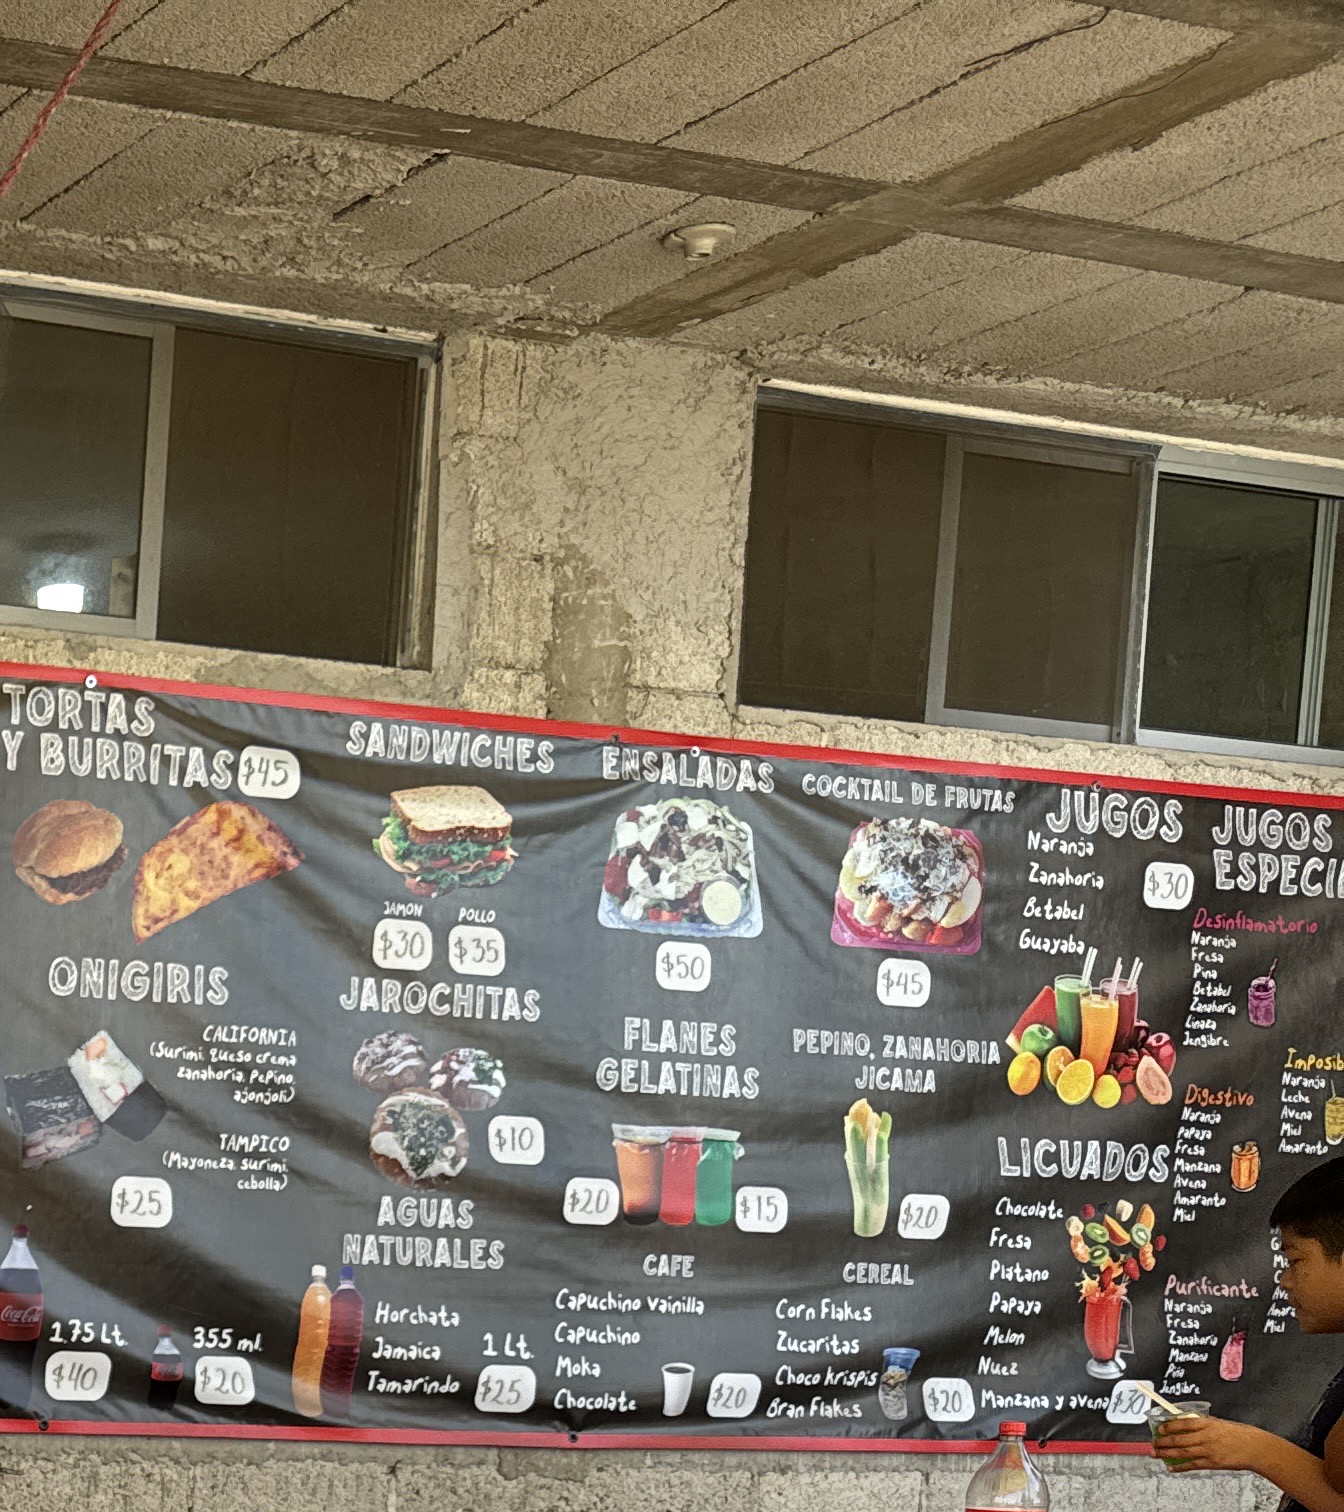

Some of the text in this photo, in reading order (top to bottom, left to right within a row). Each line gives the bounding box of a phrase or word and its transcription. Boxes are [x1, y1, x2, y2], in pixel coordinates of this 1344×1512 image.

[3, 684, 155, 736] TORTAS
[1, 730, 235, 789] Y BURRITAS
[345, 721, 555, 773] SANDWICHES
[242, 757, 289, 788] $45
[602, 747, 775, 794] ENSALADAS
[802, 773, 1015, 813] COCKTAIL DE FRUTAS
[1046, 789, 1184, 841] JUGOS
[1212, 805, 1332, 851] JUGOS
[1027, 831, 1094, 858] Naranja
[1028, 862, 1105, 890] Zanahoria
[1148, 871, 1189, 899] $30
[383, 902, 423, 917] JAMON
[458, 907, 496, 923] POLLO
[1022, 896, 1085, 922] Betabel
[1193, 907, 1318, 935] Desinflamatorio
[377, 929, 426, 960] $30
[453, 937, 500, 964] $35
[1019, 931, 1086, 957] Guayaba
[1191, 930, 1237, 948] Naranja
[661, 950, 706, 981] $50
[1191, 947, 1224, 964] Fresa
[49, 957, 229, 1005] ONIGIRIS
[881, 968, 924, 996] $45
[339, 976, 541, 1022] JAROCHITAS
[1190, 997, 1237, 1015] Zanahoria
[1185, 1014, 1217, 1030] Linaza
[203, 1025, 296, 1047] CALIFORNIA
[624, 1017, 737, 1056] FLANES
[882, 1033, 1001, 1065] ZANAHORIA
[596, 1059, 760, 1099] GELATINAS
[855, 1065, 937, 1093] JICAMA
[1282, 1071, 1325, 1089] Naranja
[1184, 1083, 1255, 1107] Digestivo
[1281, 1089, 1310, 1103] Leche
[1180, 1106, 1221, 1124] Naranja
[1280, 1105, 1312, 1121] Avena
[494, 1126, 534, 1152] $10
[1280, 1122, 1302, 1136] Miel
[220, 1133, 290, 1152] TAMPICO
[1175, 1139, 1205, 1156] Fresa
[1278, 1138, 1328, 1155] Amaranto
[997, 1135, 1170, 1183] LICUADOS
[1174, 1157, 1221, 1174] Manzana
[1174, 1173, 1207, 1189] Avena
[116, 1189, 162, 1217] $25
[568, 1187, 611, 1214] $20
[740, 1197, 779, 1222] $15
[995, 1196, 1064, 1219] Chocolate
[1173, 1190, 1226, 1207] Amaranto
[377, 1196, 475, 1230] AGUAS
[902, 1205, 938, 1230] $20
[1172, 1208, 1195, 1223] Miel
[989, 1227, 1032, 1250] Fresa
[343, 1233, 505, 1270] NATURALES
[643, 1254, 695, 1277] CAFE
[842, 1262, 914, 1286] CEREAL
[1164, 1274, 1259, 1299] Purificante
[374, 1301, 460, 1328] Horchata
[776, 1298, 873, 1322] Corn Flakes
[989, 1291, 1041, 1316] Papaya
[1164, 1299, 1212, 1315] Naranja
[554, 1321, 641, 1346] Capuchino
[1166, 1314, 1200, 1329] Fresa
[371, 1337, 442, 1362] Jamaica
[777, 1333, 860, 1355] Zucaritas
[1168, 1349, 1209, 1363] Manzana
[556, 1355, 601, 1378] Moka
[978, 1355, 1018, 1376] Nuez
[52, 1366, 98, 1391] $40
[200, 1366, 245, 1393] $20
[367, 1371, 460, 1395] Tamarindo
[480, 1375, 522, 1405] $25
[553, 1388, 637, 1412] Chocolate
[767, 1398, 863, 1419] Bran Flakes
[981, 1389, 1109, 1410] Manzana y avena
